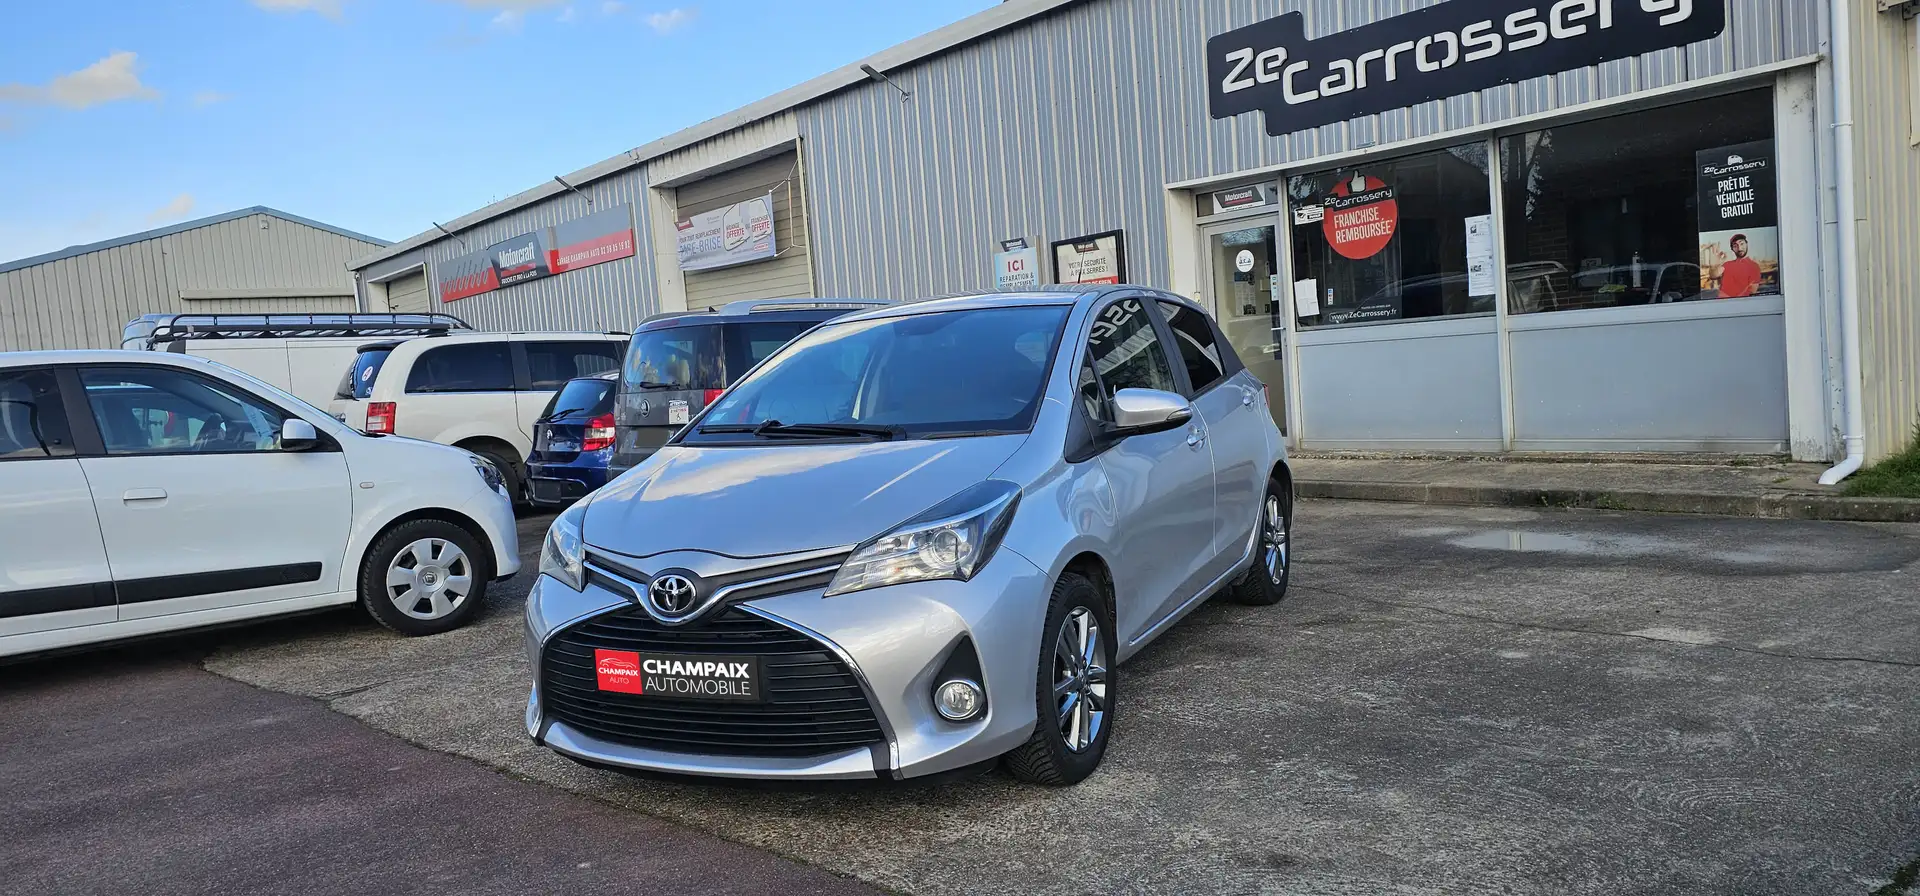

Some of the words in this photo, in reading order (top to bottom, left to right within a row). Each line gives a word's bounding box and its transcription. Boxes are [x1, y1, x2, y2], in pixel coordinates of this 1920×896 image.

[1718, 176, 1738, 192] PRÊT
[1739, 175, 1750, 188] DE
[1224, 190, 1253, 202] Motorcraft
[1716, 189, 1755, 206] VÉHICULE
[1333, 206, 1380, 229] FRANCHISE
[1721, 202, 1754, 219] GRATUIT
[726, 227, 745, 239] OFFERTE
[751, 220, 770, 233] OFFERTE
[498, 241, 536, 269] Motorcraft
[1007, 259, 1024, 273] ICI
[598, 667, 639, 677] CHAMPAIX
[643, 659, 750, 679] CHAMPAIX
[609, 677, 630, 685] AUTO
[645, 677, 752, 696] AUTOMOBILE
